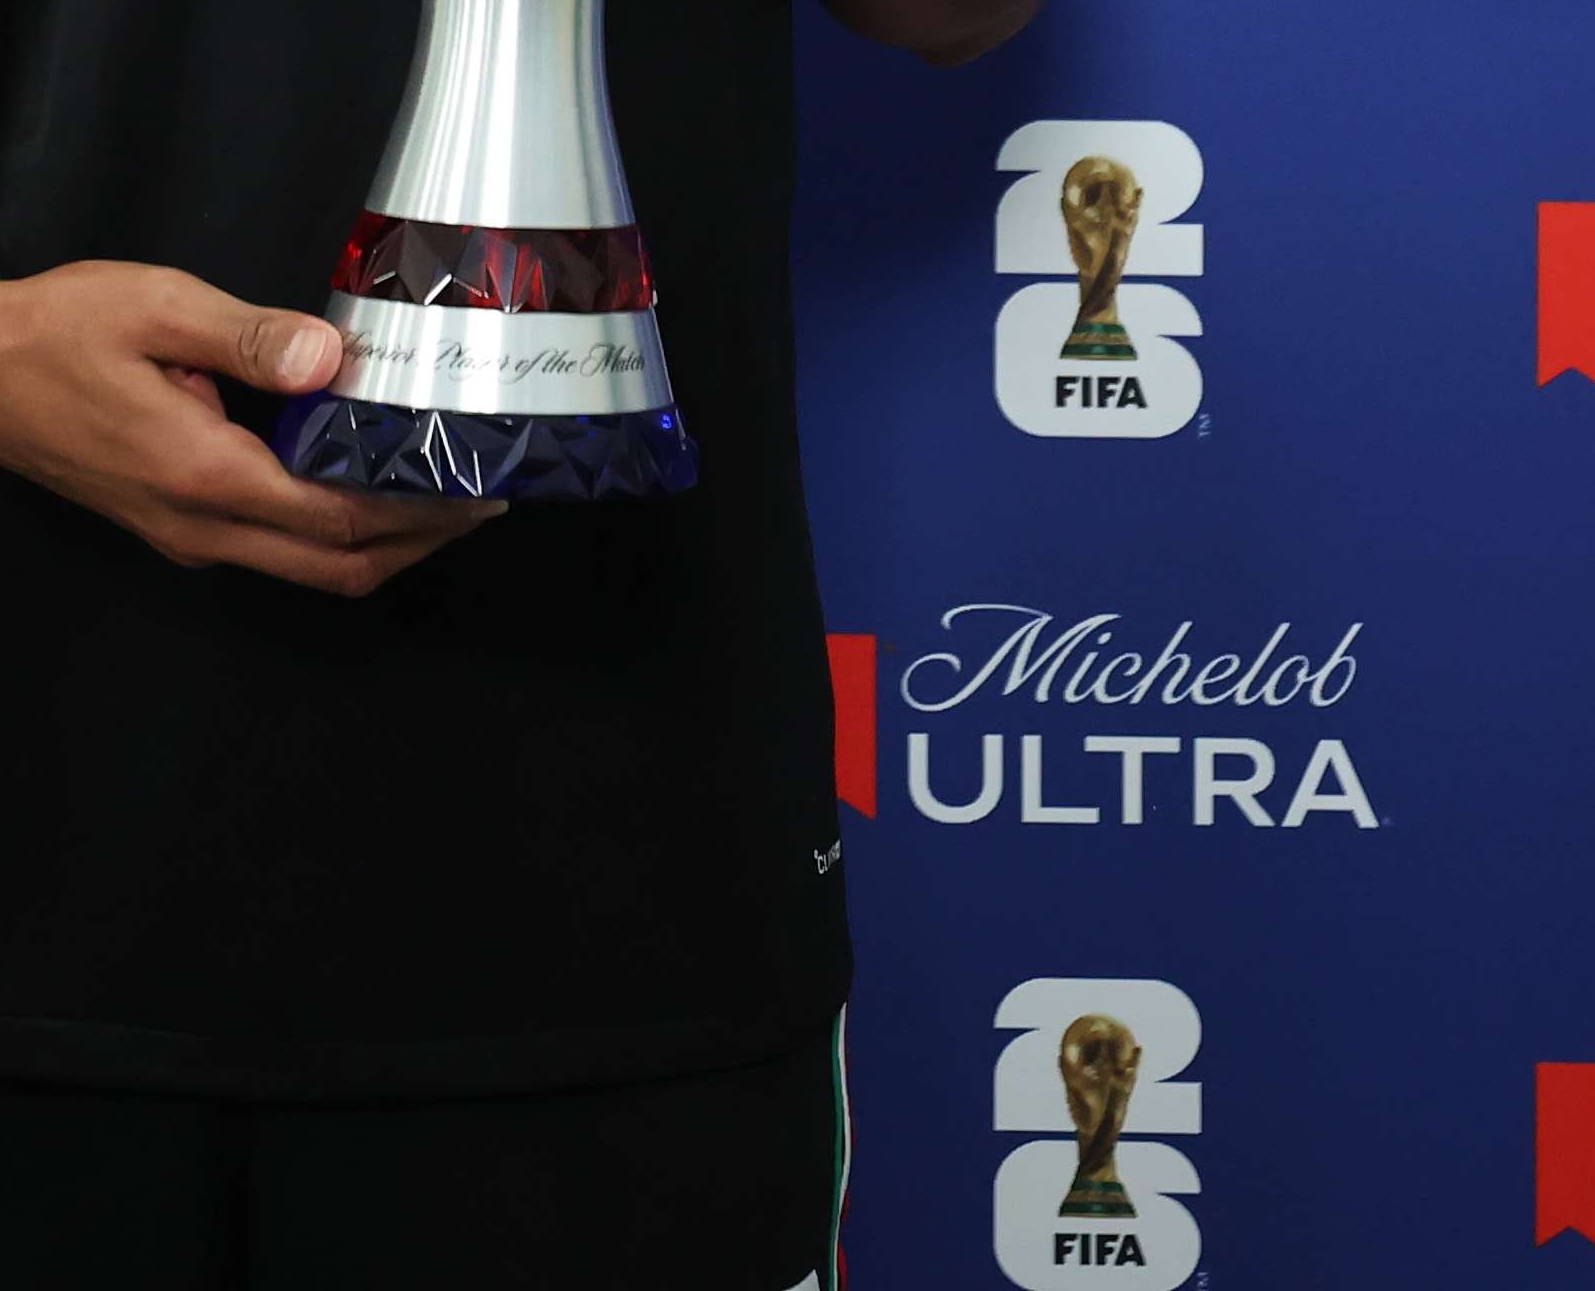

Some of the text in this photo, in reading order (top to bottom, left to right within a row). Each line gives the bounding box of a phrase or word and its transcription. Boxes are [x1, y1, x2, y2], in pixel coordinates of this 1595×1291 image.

[541, 346, 579, 374] the
[1055, 375, 1147, 409] FIFA
[901, 603, 1364, 712] Michelob
[907, 732, 1380, 829] ULTRA
[1054, 1232, 1146, 1267] FIFA
